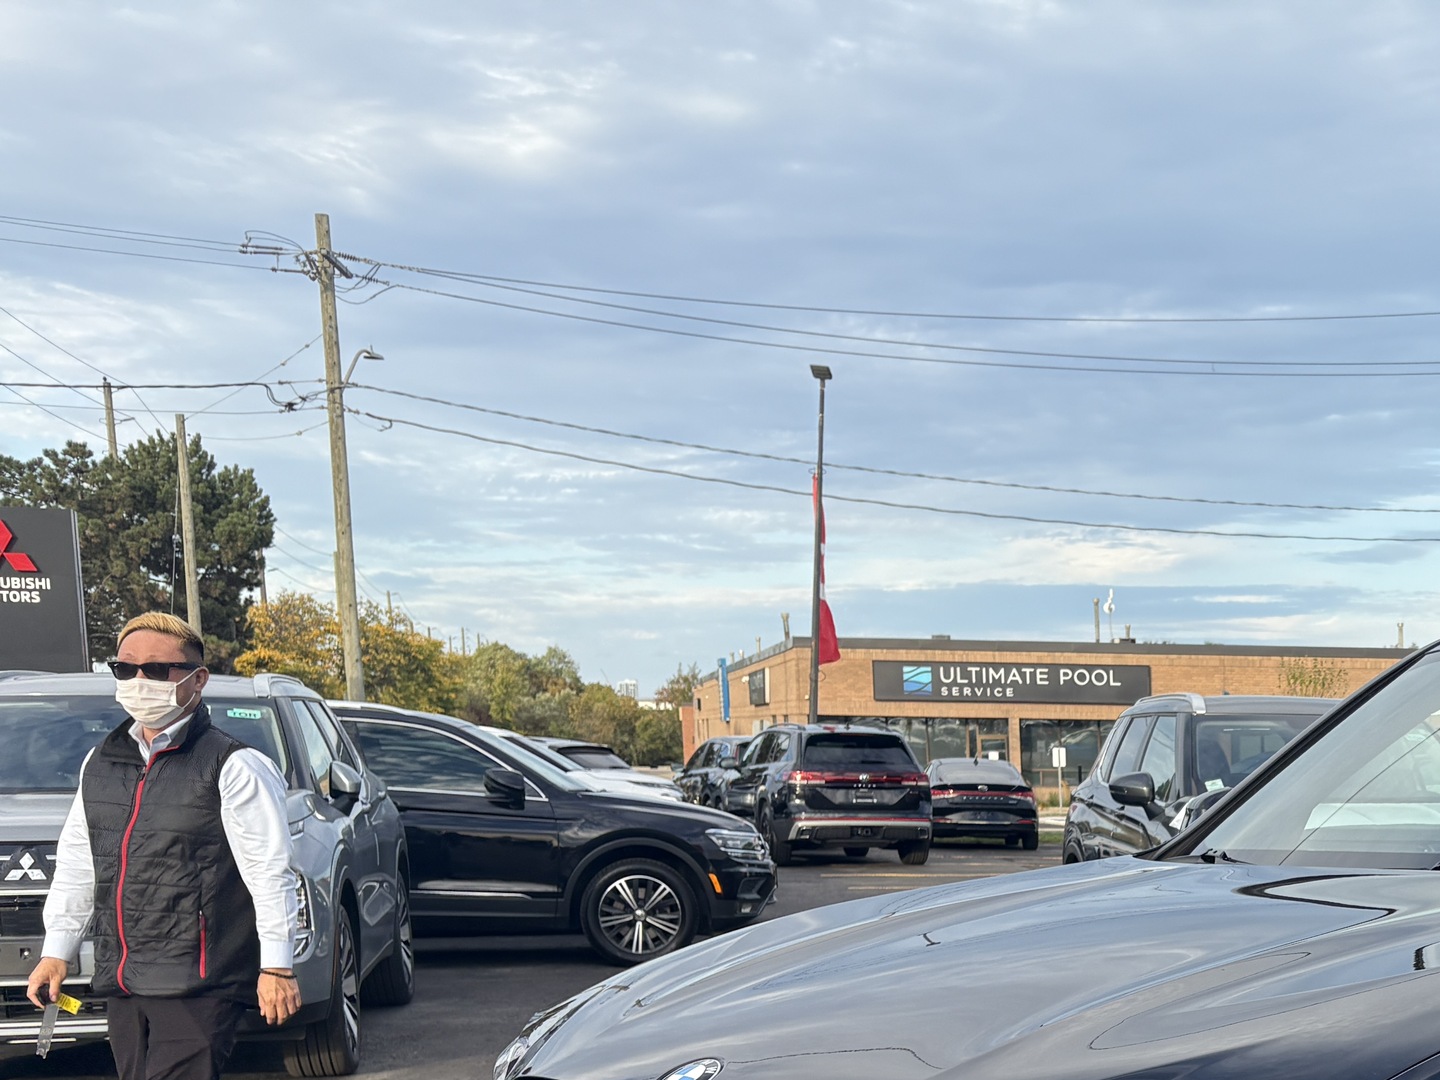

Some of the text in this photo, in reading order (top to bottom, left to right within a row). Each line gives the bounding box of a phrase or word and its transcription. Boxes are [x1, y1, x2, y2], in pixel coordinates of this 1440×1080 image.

[940, 666, 1122, 686] ULTIMATE POOL
[941, 686, 1014, 697] SERVICE
